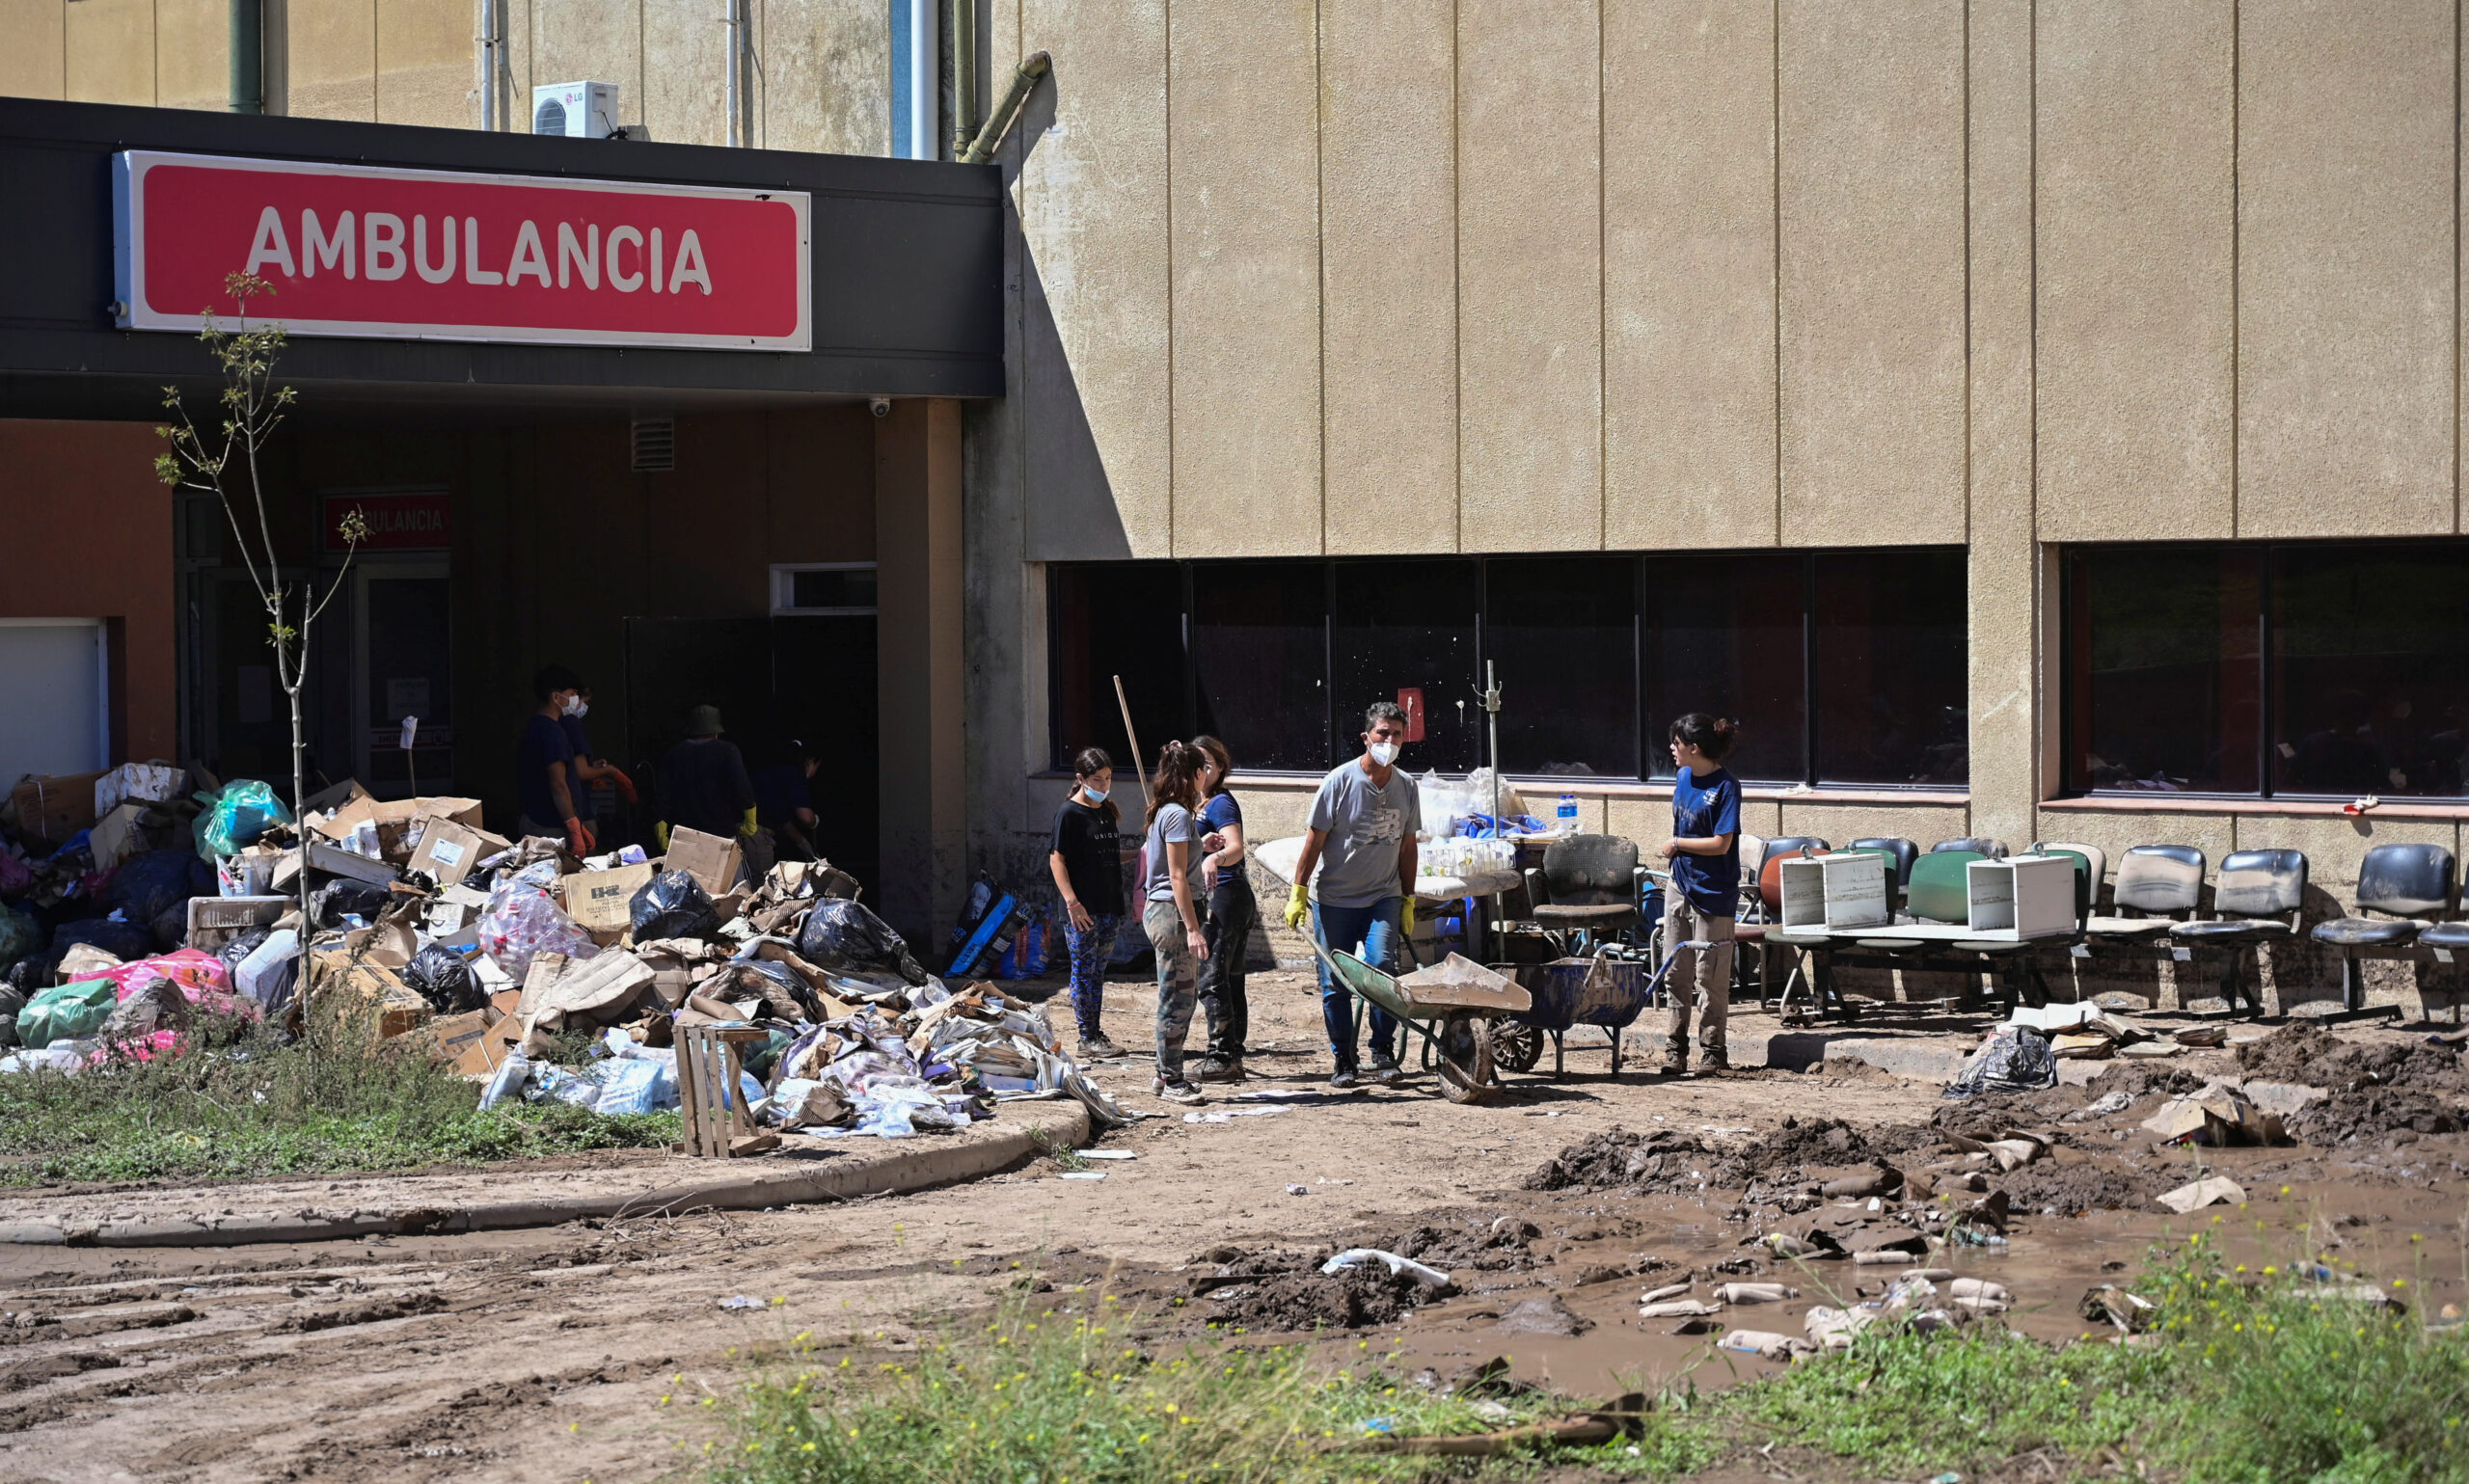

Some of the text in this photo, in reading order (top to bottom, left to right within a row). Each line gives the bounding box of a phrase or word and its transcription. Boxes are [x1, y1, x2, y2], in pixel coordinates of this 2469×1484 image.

[573, 92, 583, 102] LG
[245, 205, 713, 296] AMBULANCIA
[344, 508, 444, 532] BULANCIA
